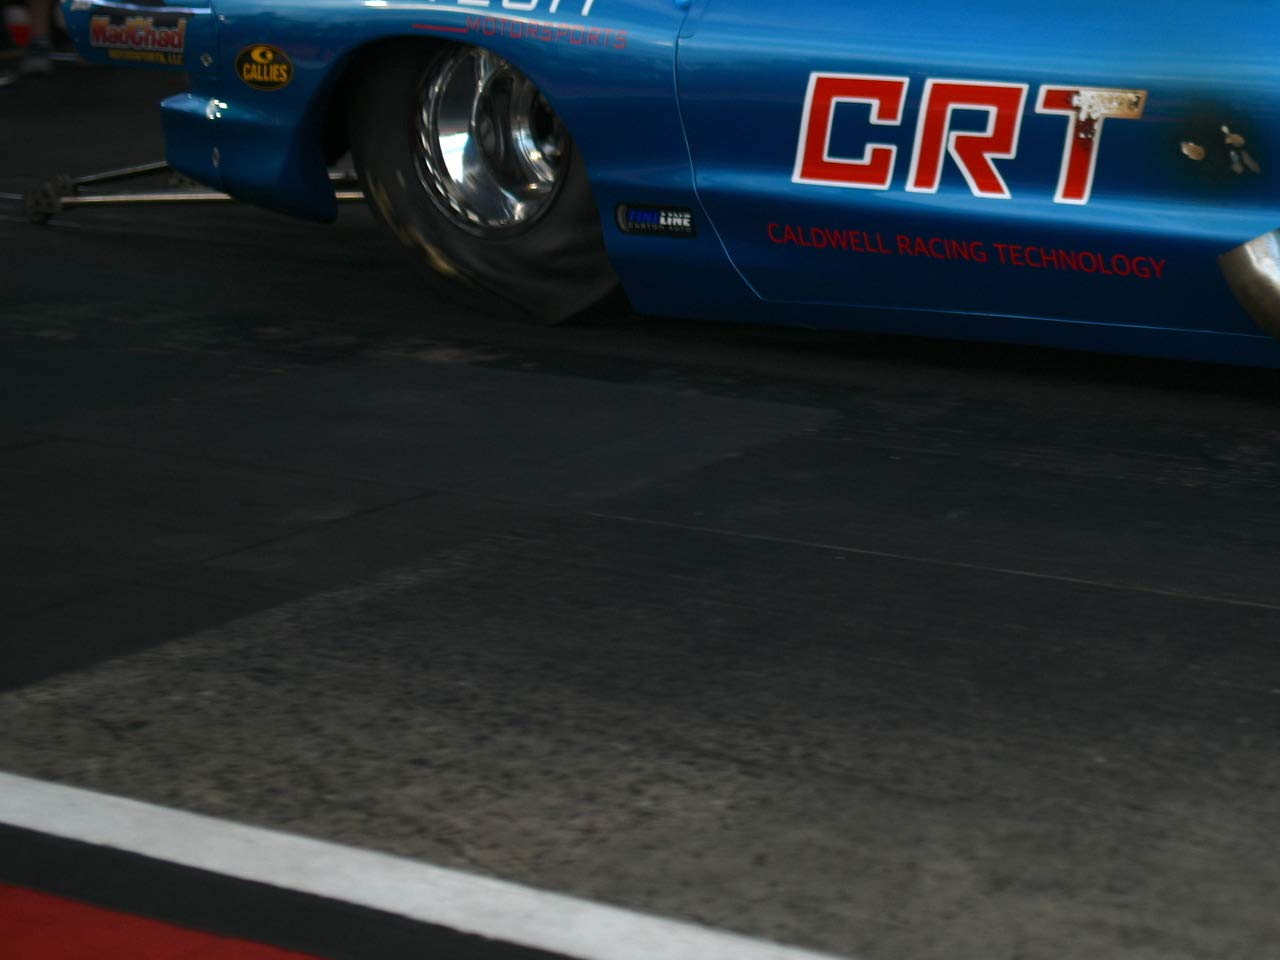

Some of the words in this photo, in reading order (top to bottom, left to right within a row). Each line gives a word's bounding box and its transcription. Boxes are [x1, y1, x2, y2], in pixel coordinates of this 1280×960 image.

[466, 15, 629, 49] MOTORSPORTS
[242, 62, 288, 82] CALLIES
[792, 71, 1148, 205] CRT
[768, 223, 891, 254] CALDWELL
[897, 235, 988, 263] RACING
[994, 243, 1167, 279] TECHNOLOGY
